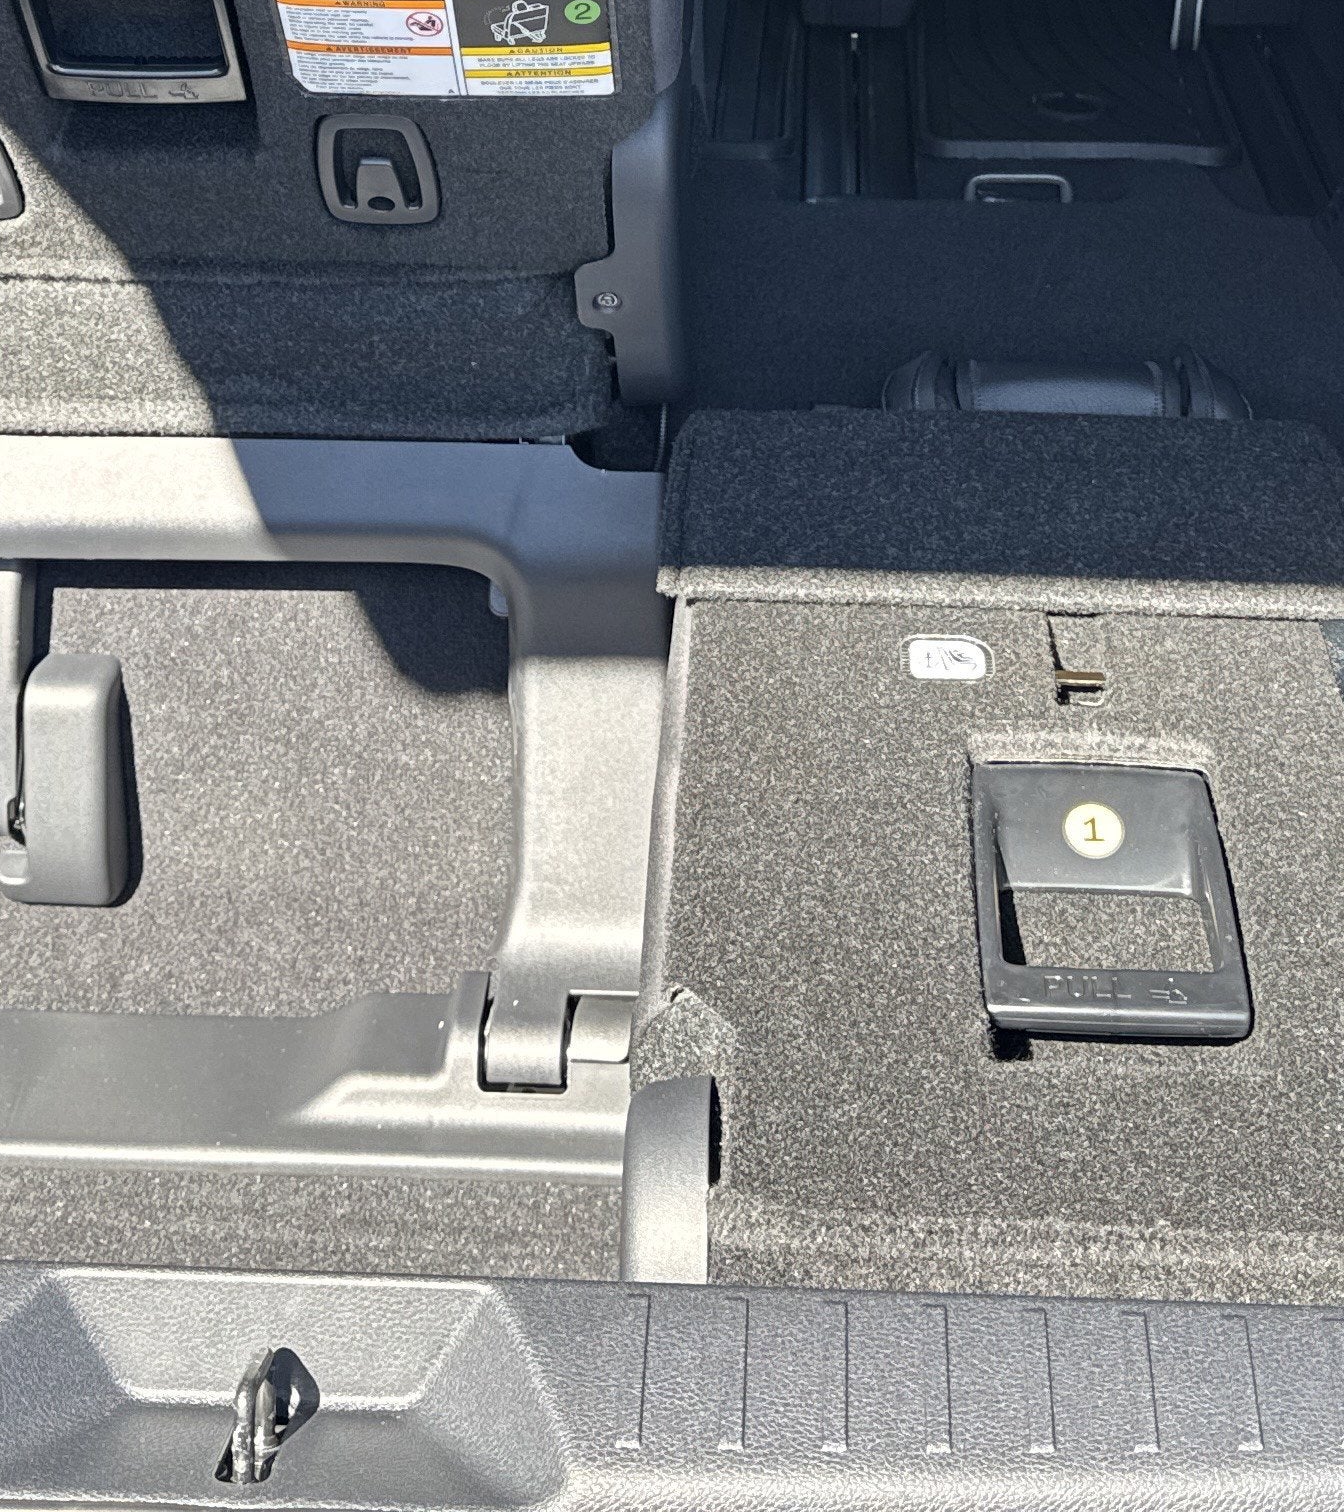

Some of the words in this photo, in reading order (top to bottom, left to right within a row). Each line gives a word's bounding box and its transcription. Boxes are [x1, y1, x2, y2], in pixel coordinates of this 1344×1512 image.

[574, 2, 593, 21] 2
[1083, 816, 1105, 842] 1
[1043, 975, 1132, 999] PULL
